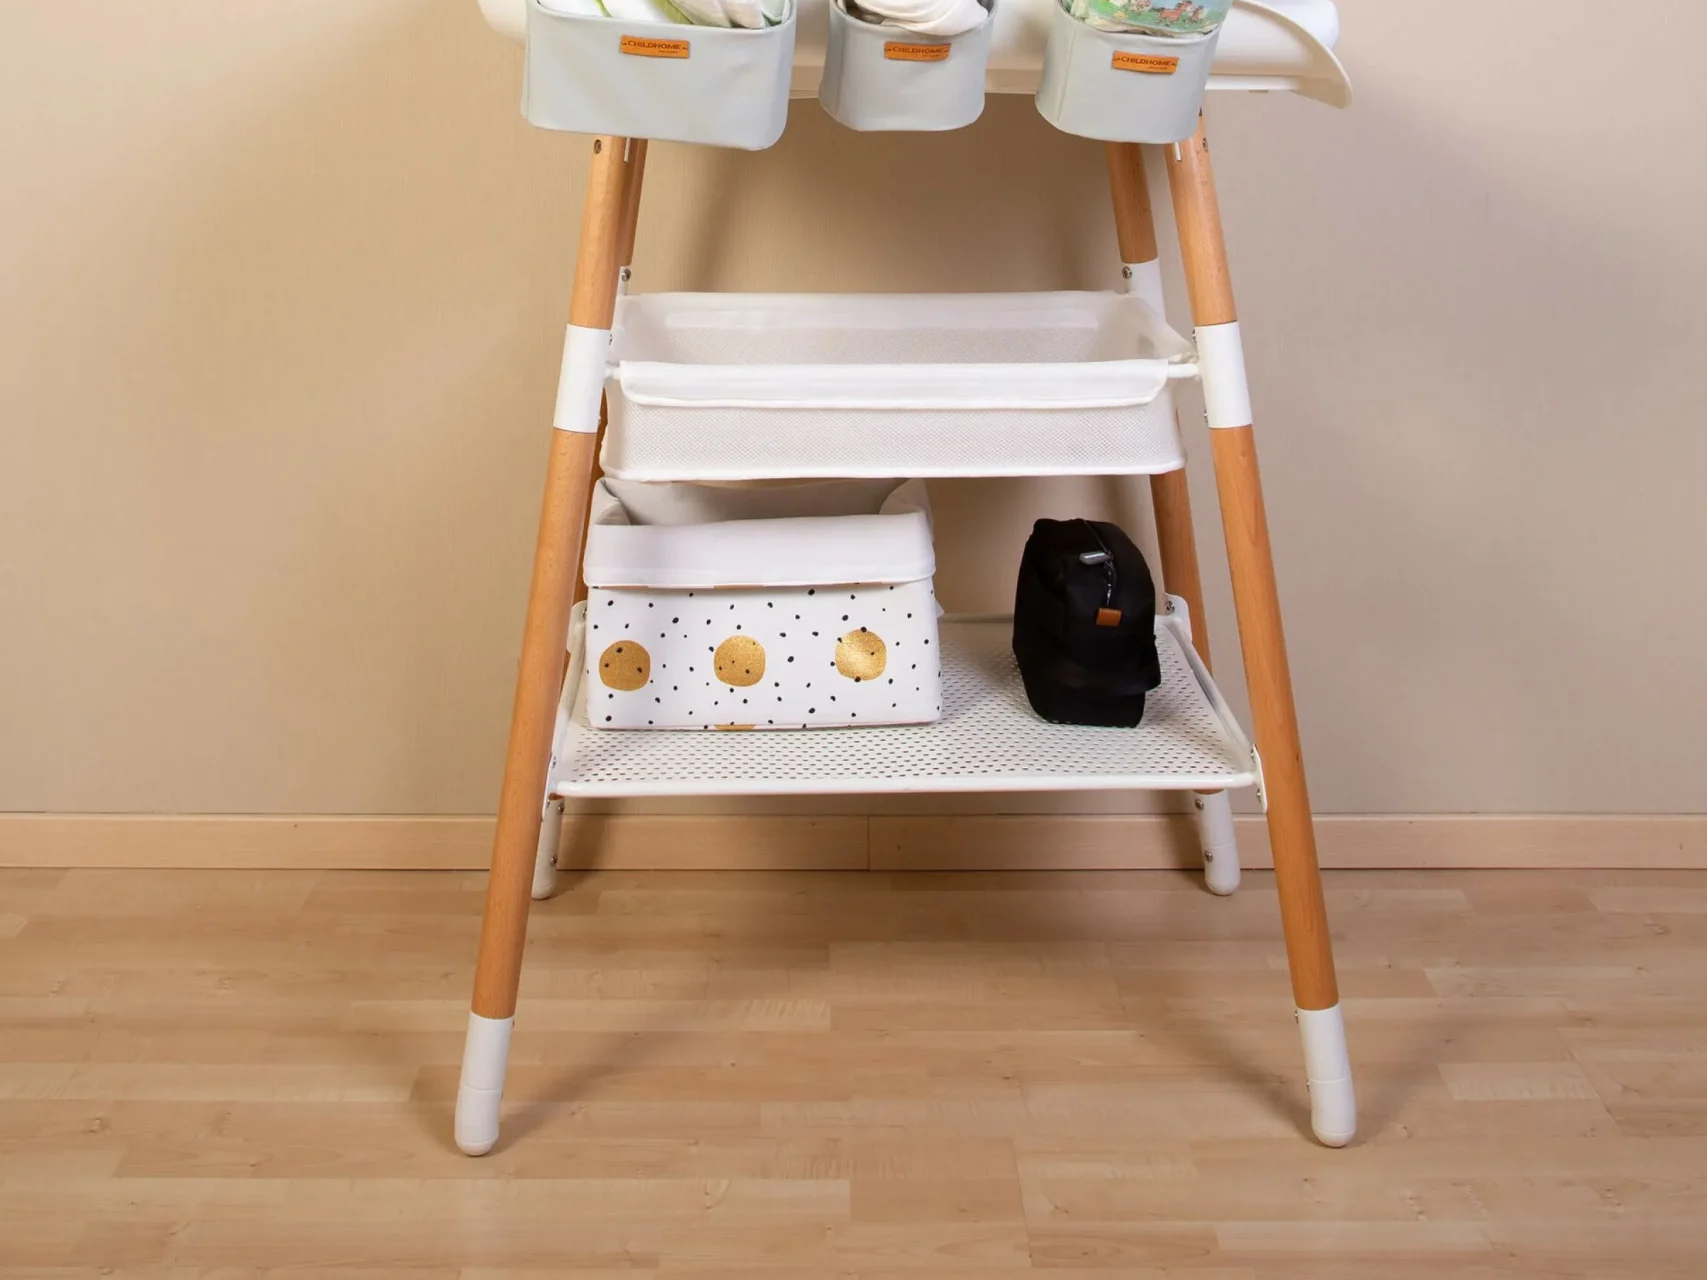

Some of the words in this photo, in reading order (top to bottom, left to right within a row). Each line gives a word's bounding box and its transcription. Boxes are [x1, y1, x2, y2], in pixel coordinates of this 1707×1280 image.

[627, 40, 681, 50] CHILDHOME
[892, 46, 943, 55] CHILDHOME
[1121, 56, 1171, 66] CHILDHOME
